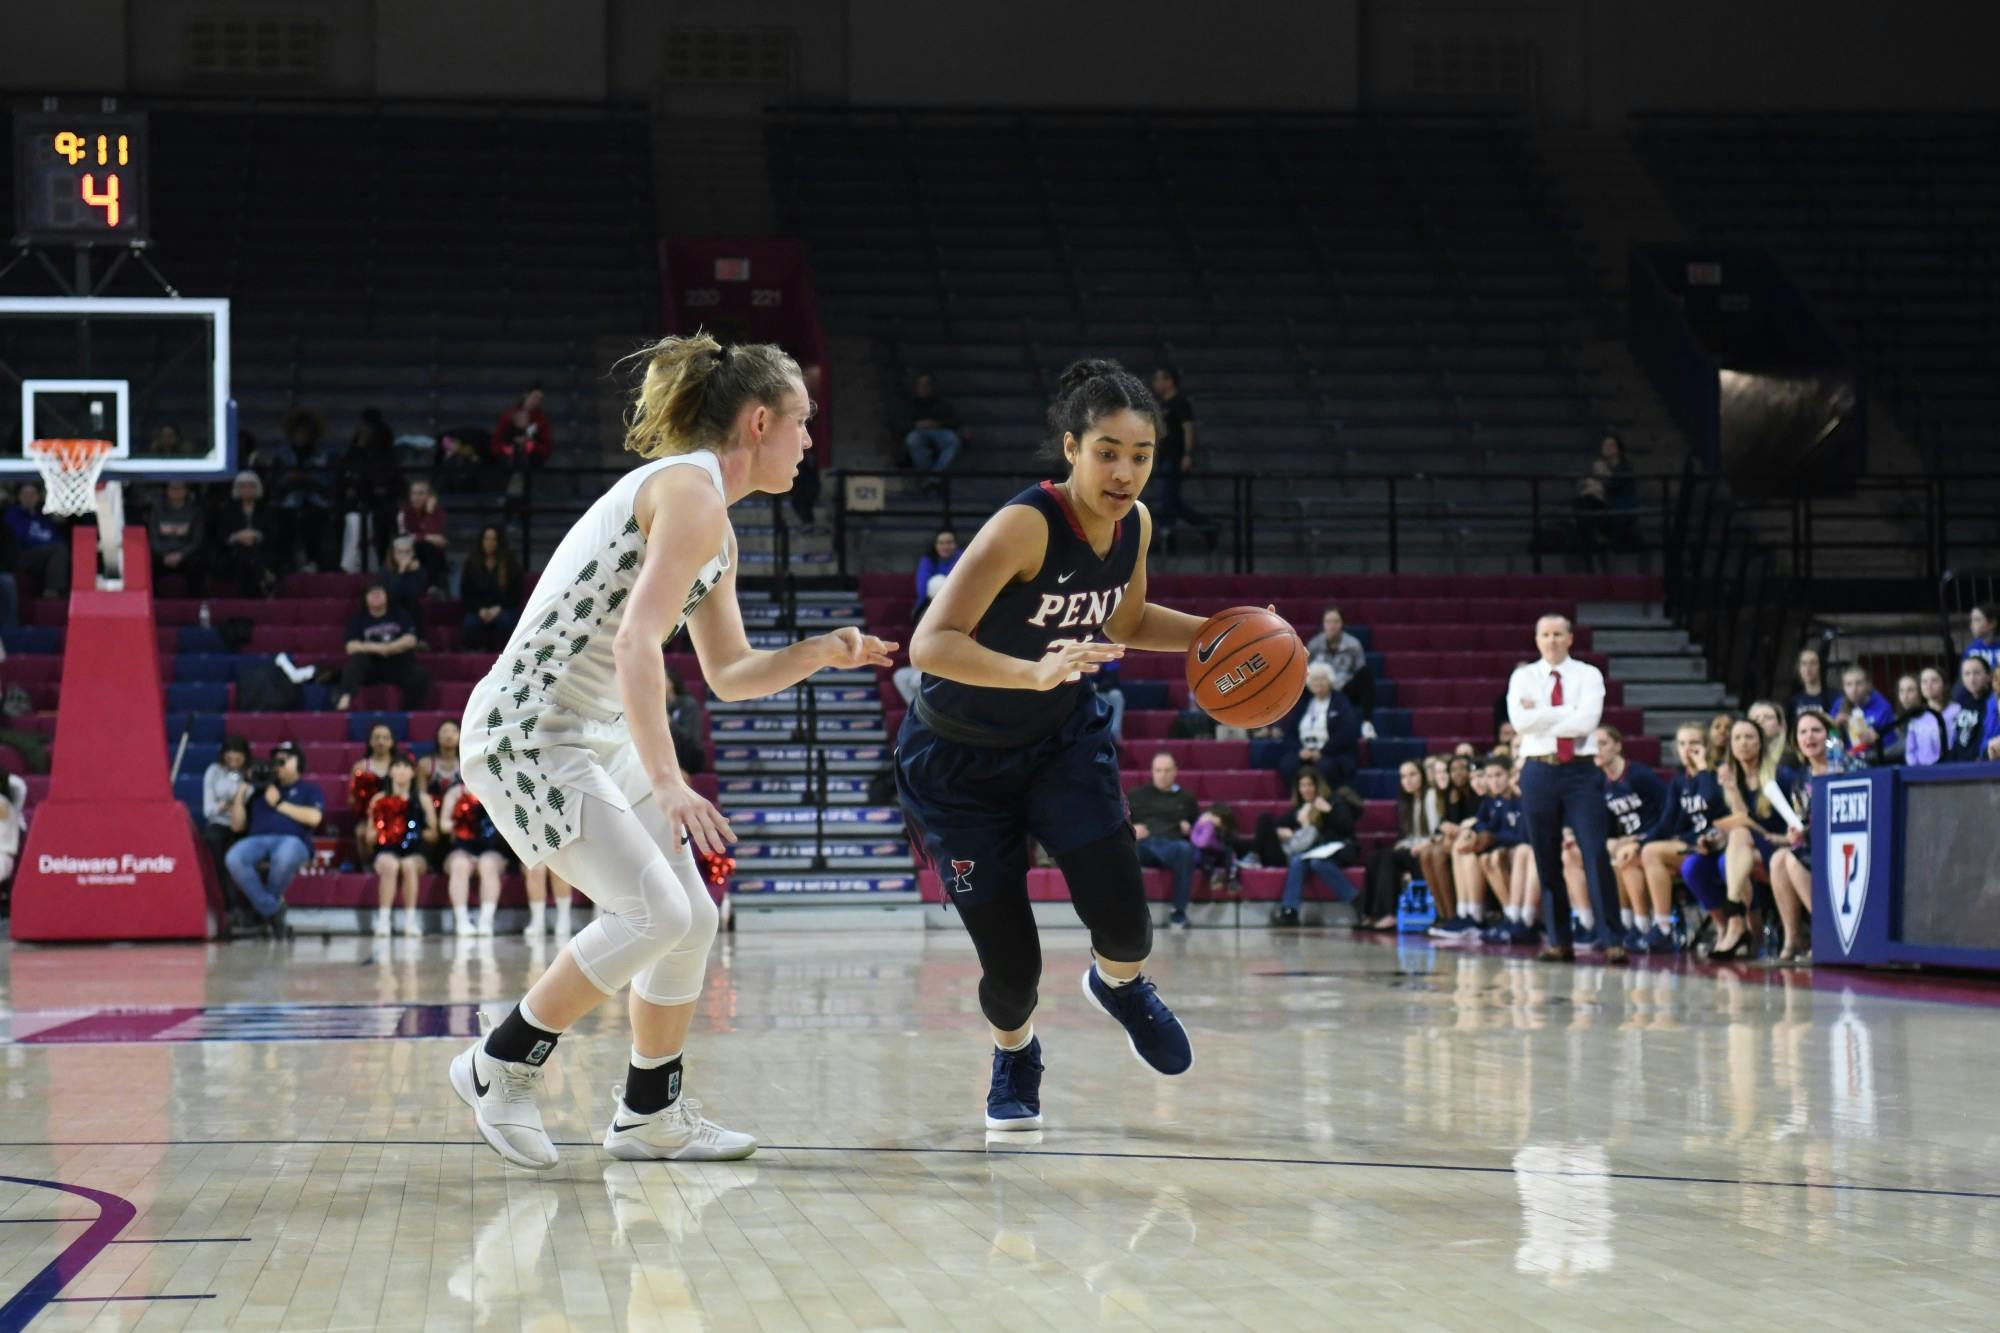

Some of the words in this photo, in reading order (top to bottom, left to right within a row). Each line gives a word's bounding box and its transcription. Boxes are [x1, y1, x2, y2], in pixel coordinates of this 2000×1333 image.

[54, 131, 129, 166] 9:11
[82, 173, 120, 227] 4
[1214, 652, 1267, 697] ELITE
[1831, 791, 1868, 825] PENN
[39, 854, 118, 874] Delaware
[121, 854, 174, 874] Funds
